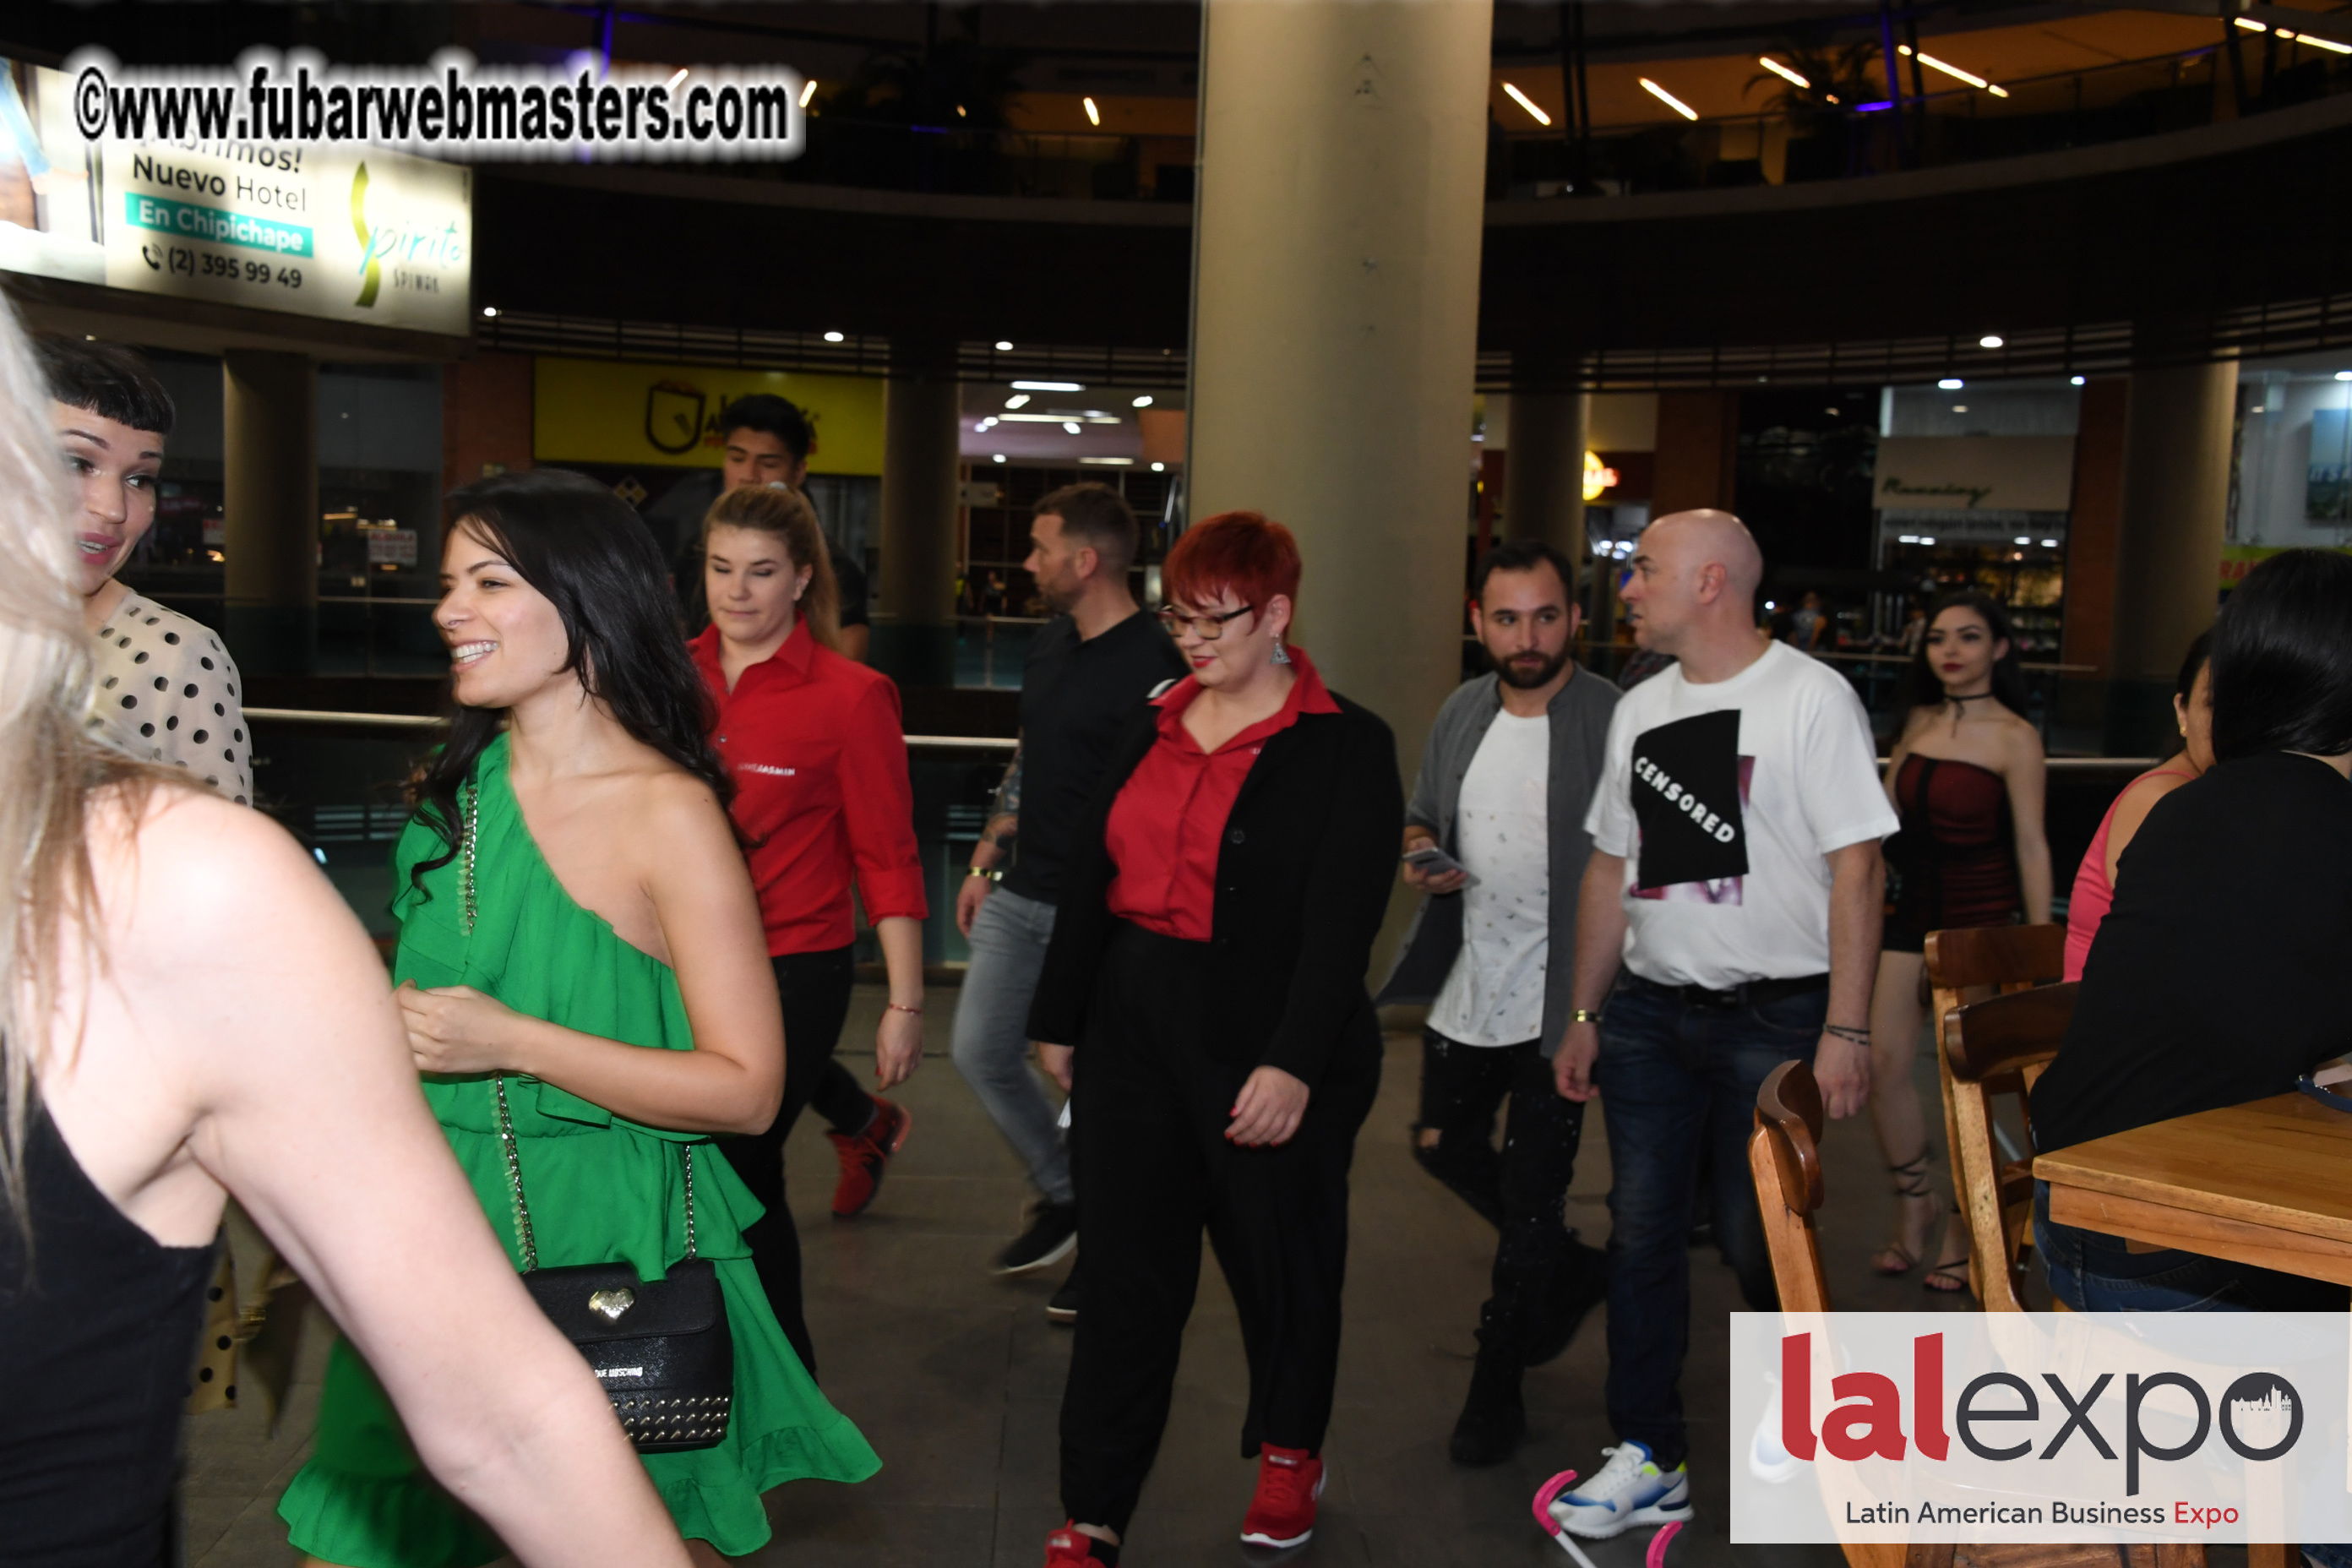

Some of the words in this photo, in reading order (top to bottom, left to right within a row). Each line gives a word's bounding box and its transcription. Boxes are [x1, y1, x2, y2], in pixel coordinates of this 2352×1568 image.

[133, 153, 226, 197] Nuevo
[237, 176, 308, 214] Hotel
[139, 199, 170, 226] En
[177, 208, 305, 254] Chipichape
[168, 246, 194, 277] (2)
[202, 253, 239, 280] 395
[246, 261, 270, 284] 99
[277, 268, 302, 289] 49
[1634, 756, 1735, 843] CENSORED
